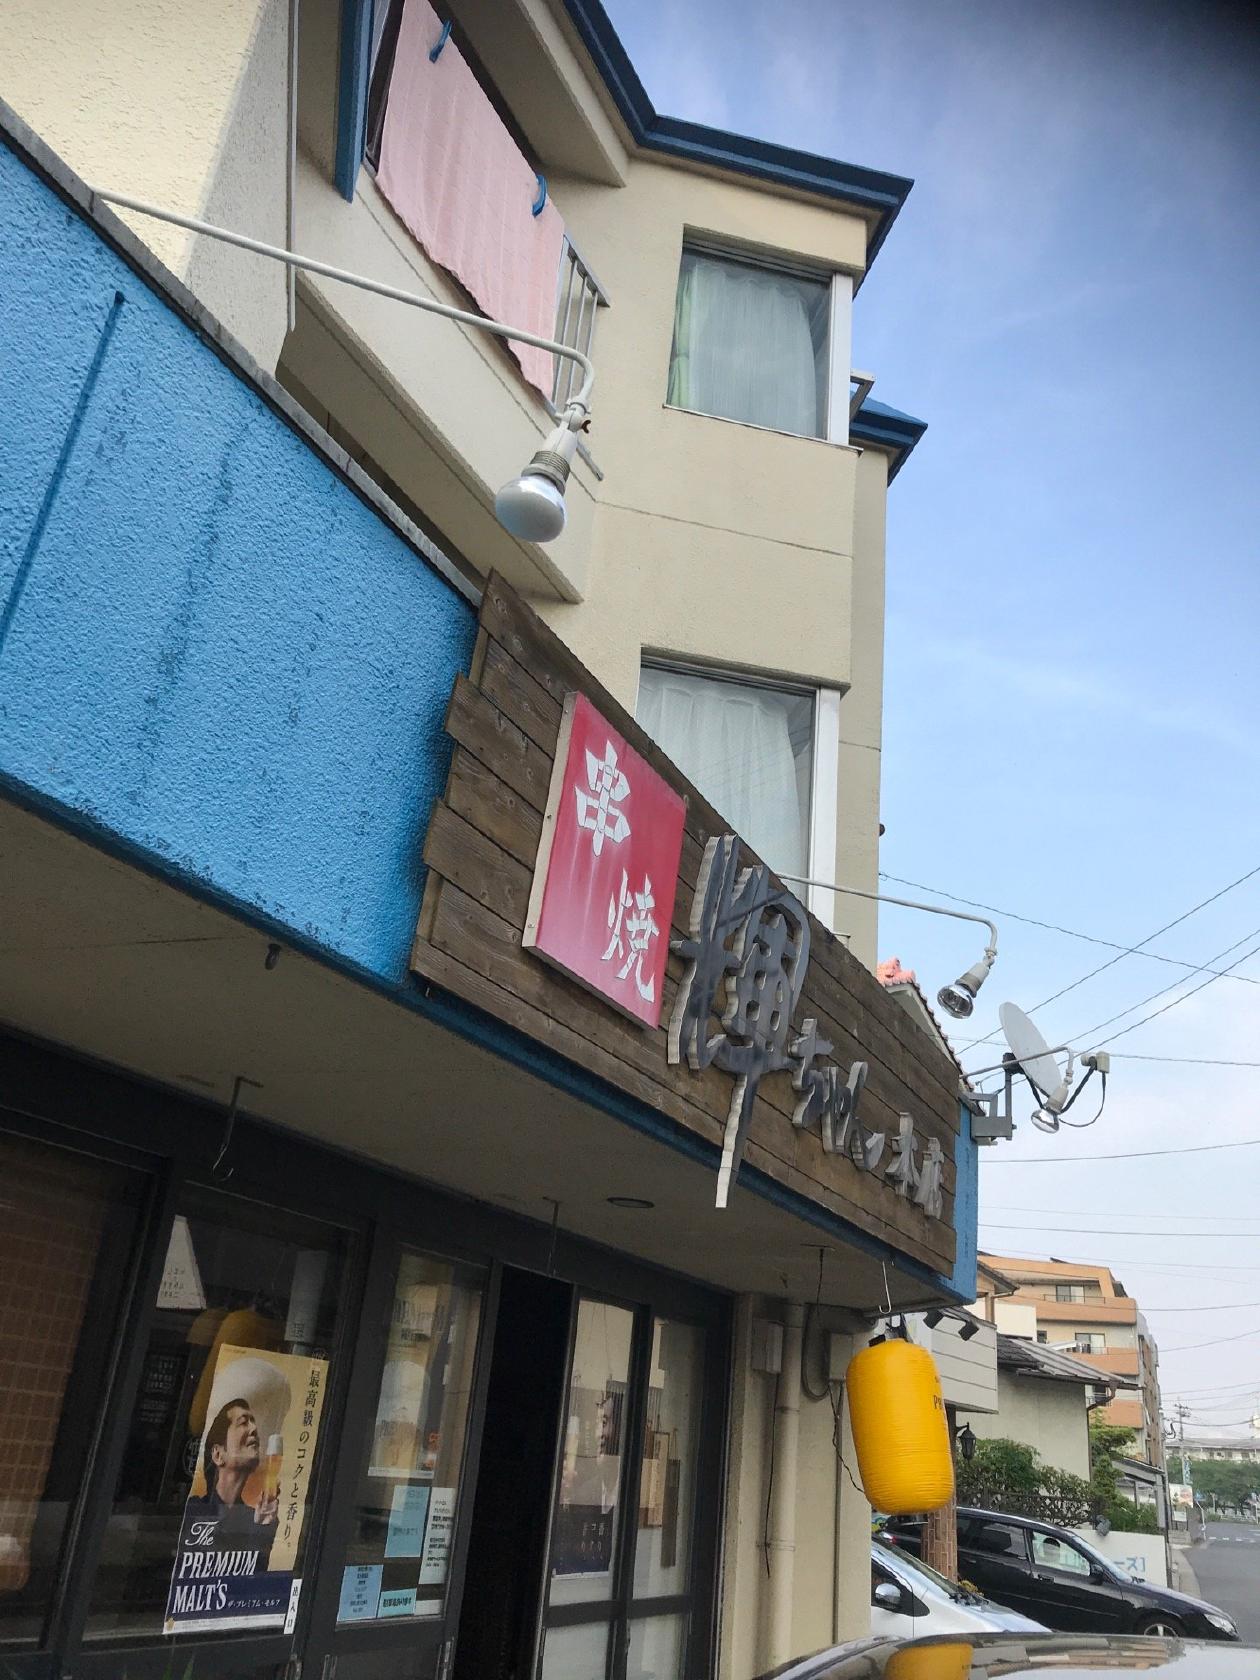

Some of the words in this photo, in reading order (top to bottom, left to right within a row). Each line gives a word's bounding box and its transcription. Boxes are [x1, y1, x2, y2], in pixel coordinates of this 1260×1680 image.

[574, 739, 661, 1003] 串焼
[185, 1520, 219, 1546] The
[178, 1550, 260, 1579] PREMIUM
[172, 1579, 229, 1614] MALT'S
